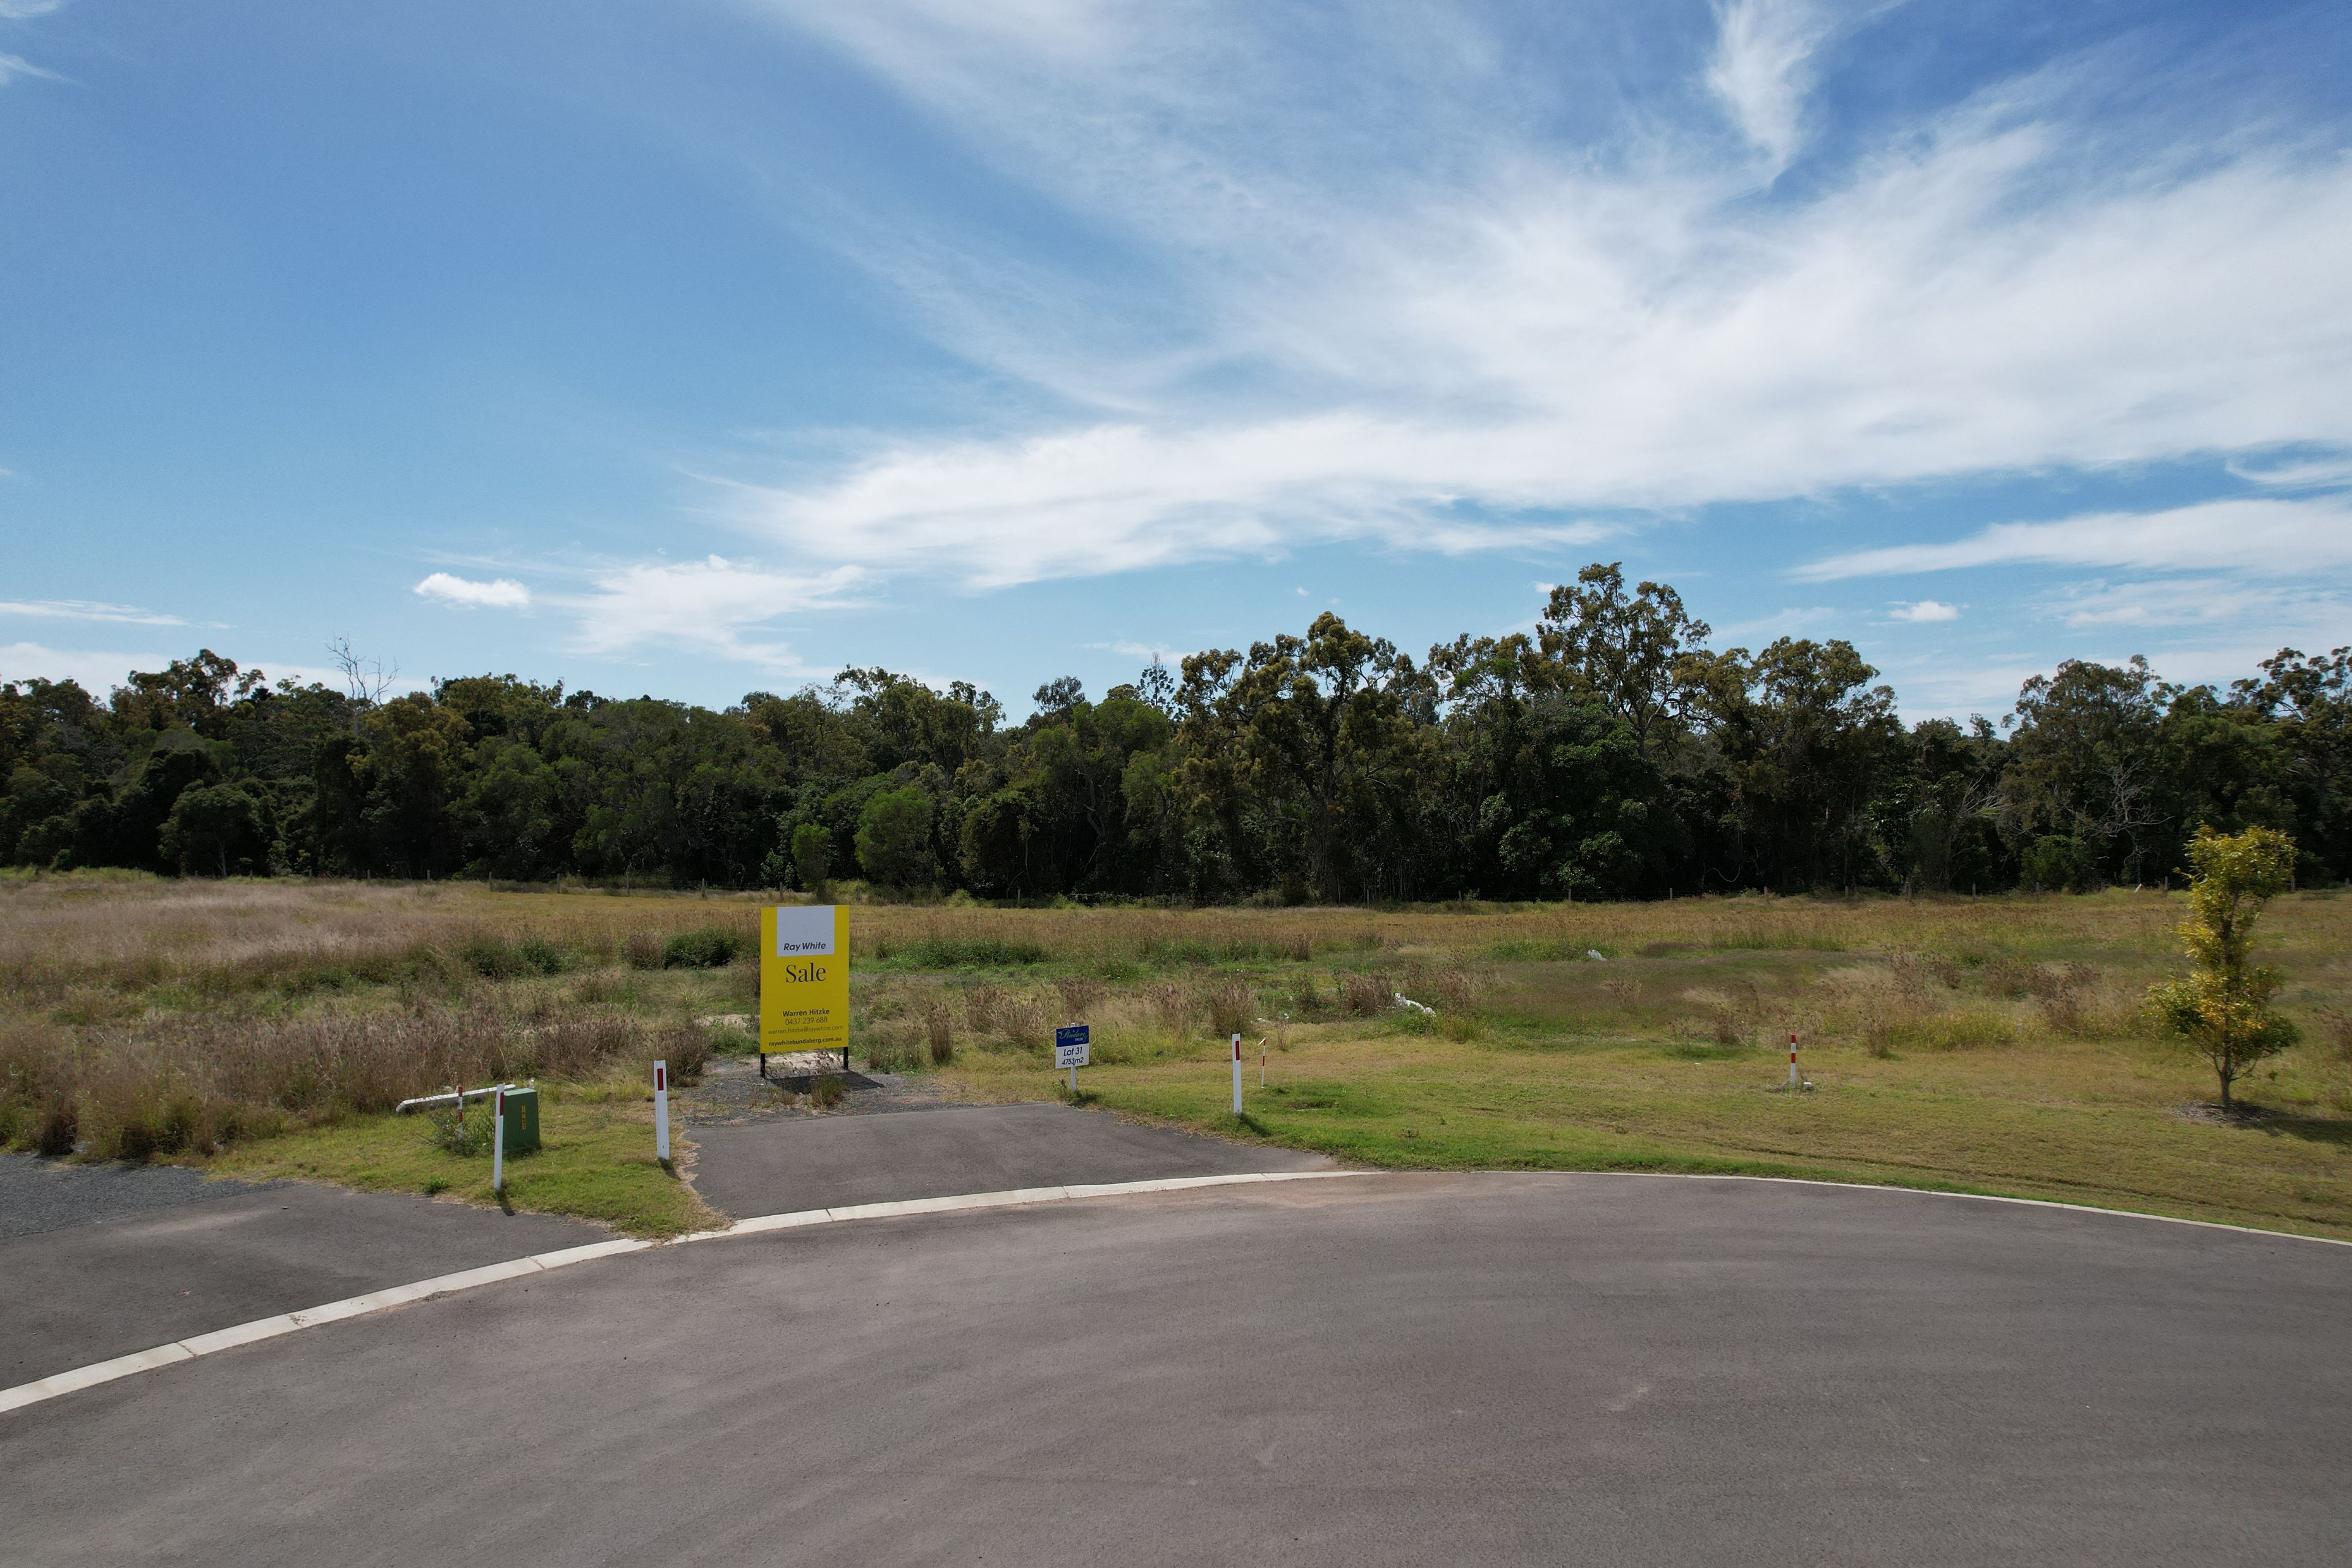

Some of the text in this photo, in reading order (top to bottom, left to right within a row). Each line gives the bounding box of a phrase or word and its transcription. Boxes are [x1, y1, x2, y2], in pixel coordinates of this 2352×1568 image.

[783, 941, 826, 951] Ray White
[786, 962, 826, 983] Sale
[768, 1025, 843, 1035] warren.hitzke@raywhite.com
[769, 1037, 842, 1047] raywhitebundaberg.com.au
